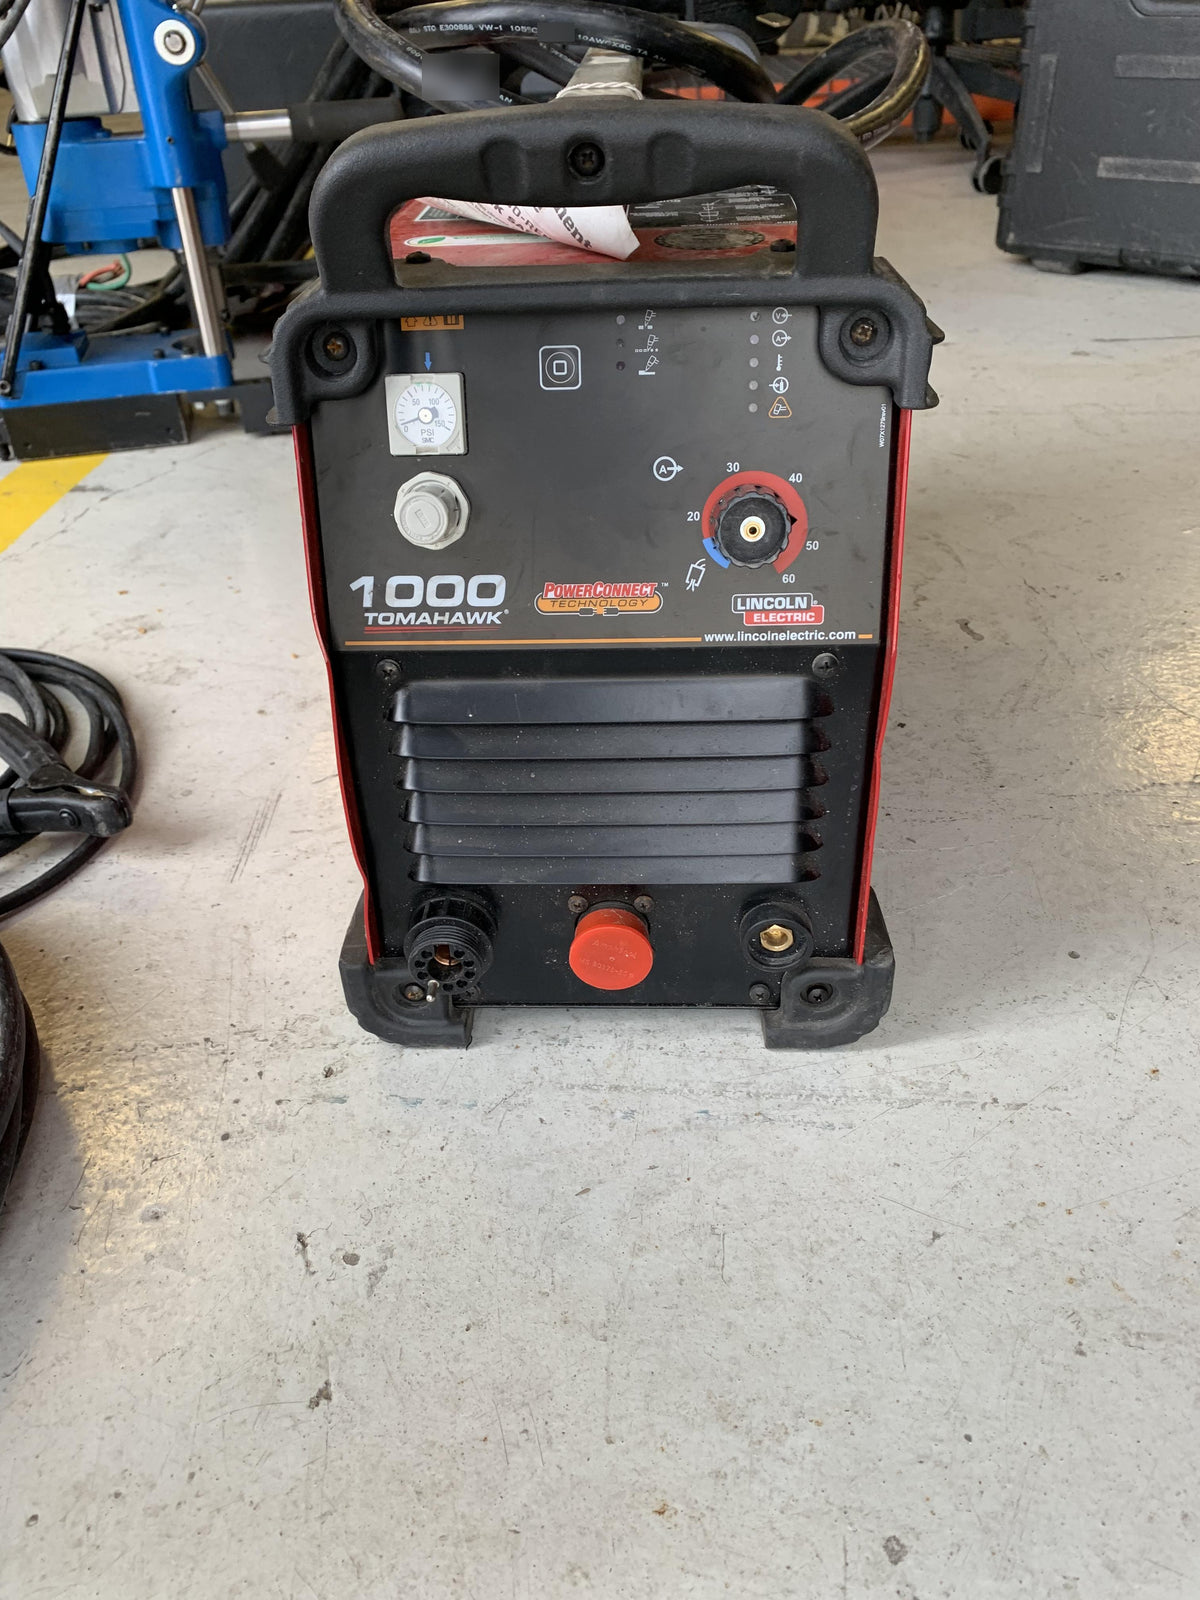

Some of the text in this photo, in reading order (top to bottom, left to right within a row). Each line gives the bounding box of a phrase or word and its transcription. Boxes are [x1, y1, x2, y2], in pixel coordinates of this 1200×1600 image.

[411, 397, 440, 406] 50 100
[403, 424, 409, 433] 0
[434, 420, 446, 428] 150
[420, 428, 435, 437] PSI
[726, 462, 741, 473] 30
[788, 473, 803, 483] 40
[687, 511, 700, 522] 20
[805, 541, 820, 551] 50
[782, 573, 796, 584] 60
[349, 574, 507, 608] 1000
[550, 598, 649, 608] TECHNOLOGY
[736, 596, 808, 611] LINCOLN
[364, 611, 503, 626] TOMAHAWK
[753, 612, 816, 623] ELECTRIC
[704, 629, 857, 643] www.lincolnelectric.com
